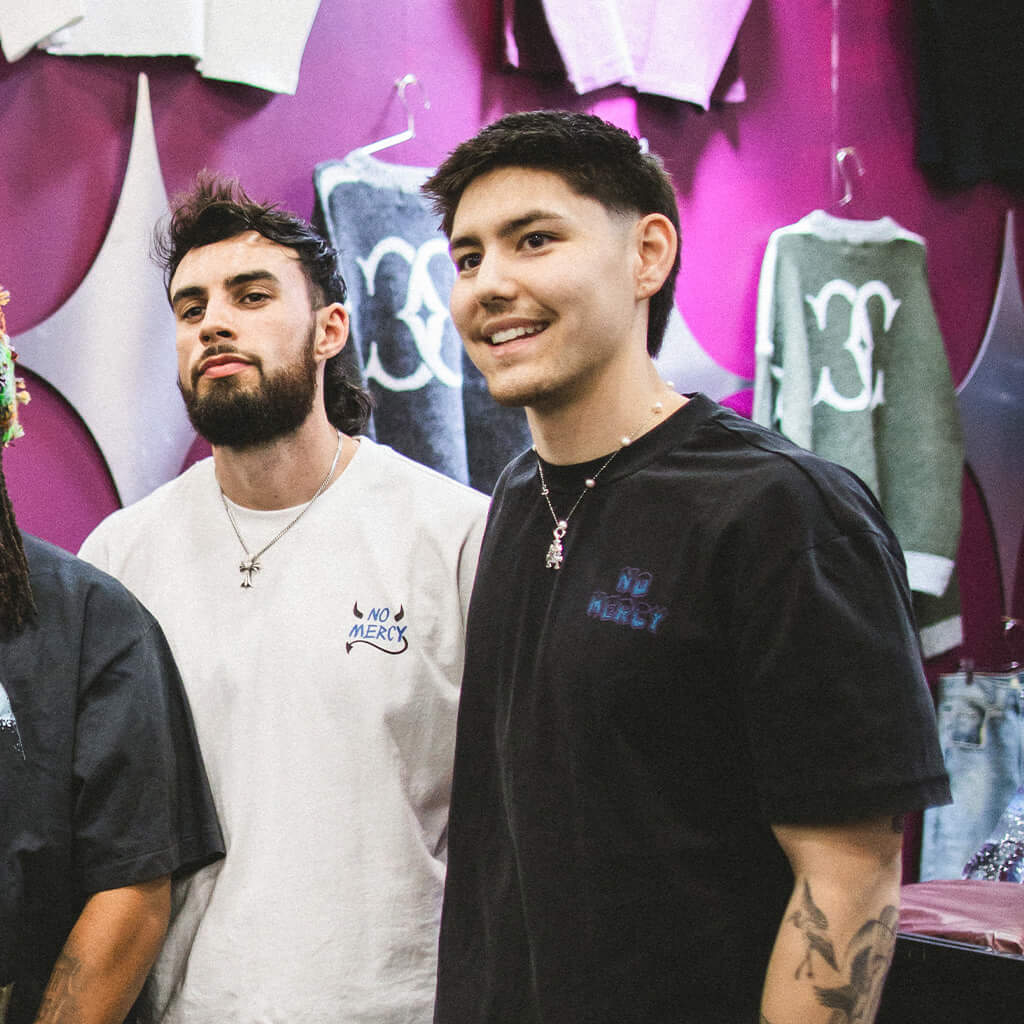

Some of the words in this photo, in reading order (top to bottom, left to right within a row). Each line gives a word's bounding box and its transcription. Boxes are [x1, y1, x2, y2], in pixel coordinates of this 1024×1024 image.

[616, 566, 653, 598] NO
[367, 607, 390, 623] NO
[587, 591, 669, 634] MERCY
[348, 624, 407, 643] MERCY
